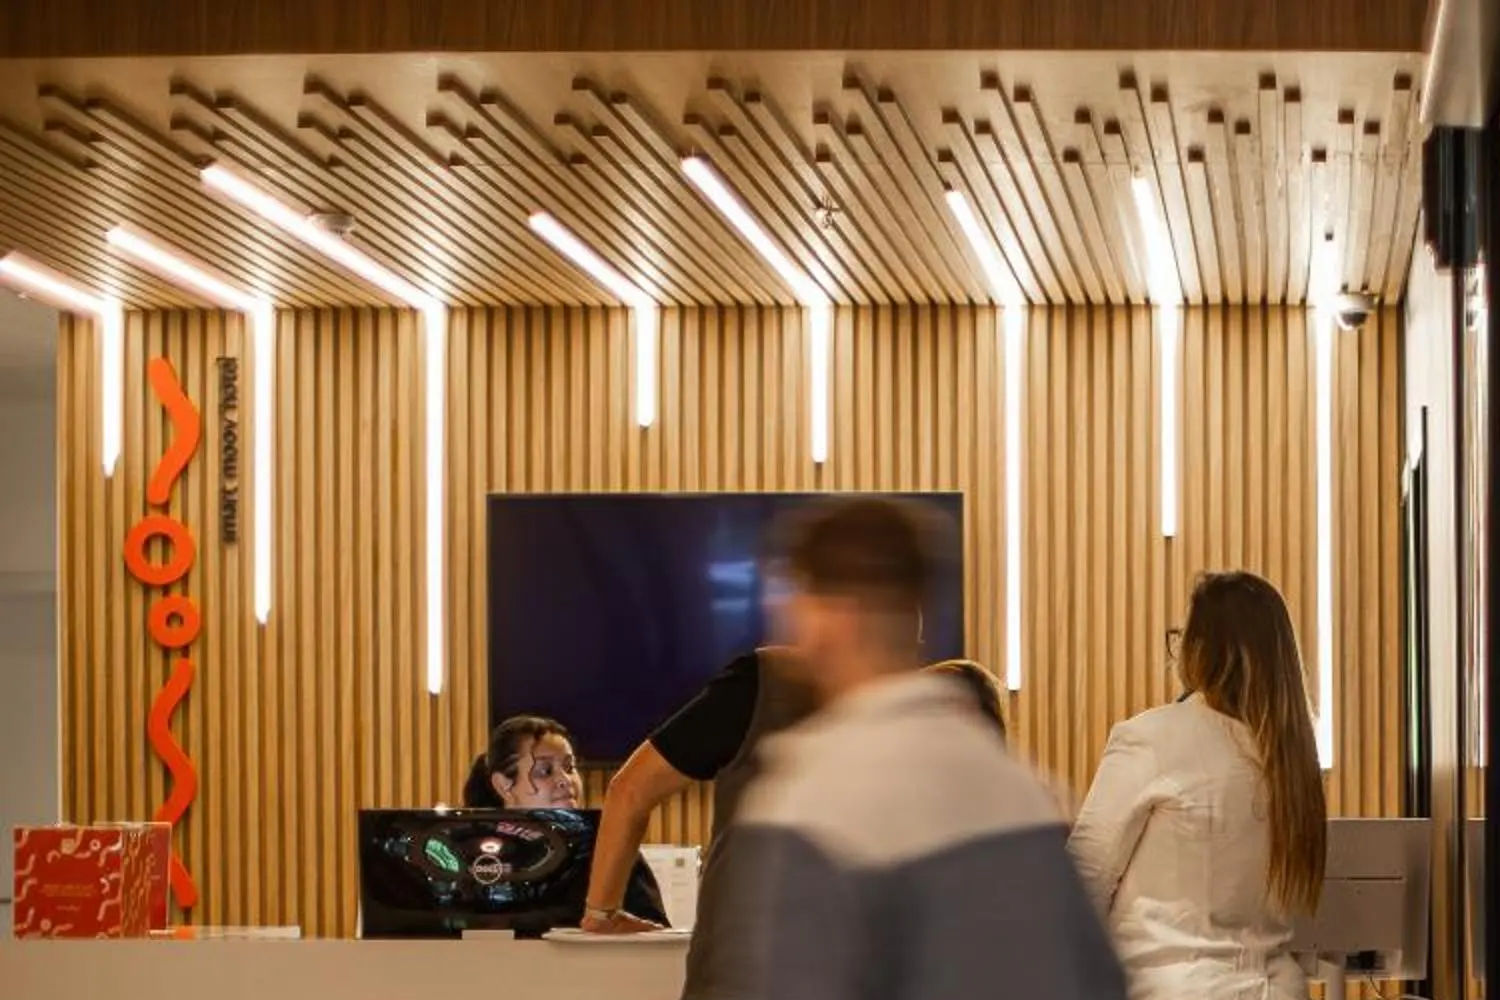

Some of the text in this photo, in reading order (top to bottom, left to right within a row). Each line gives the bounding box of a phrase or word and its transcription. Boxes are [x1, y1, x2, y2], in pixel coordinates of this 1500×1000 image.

[216, 356, 239, 545] smart moov hotel
